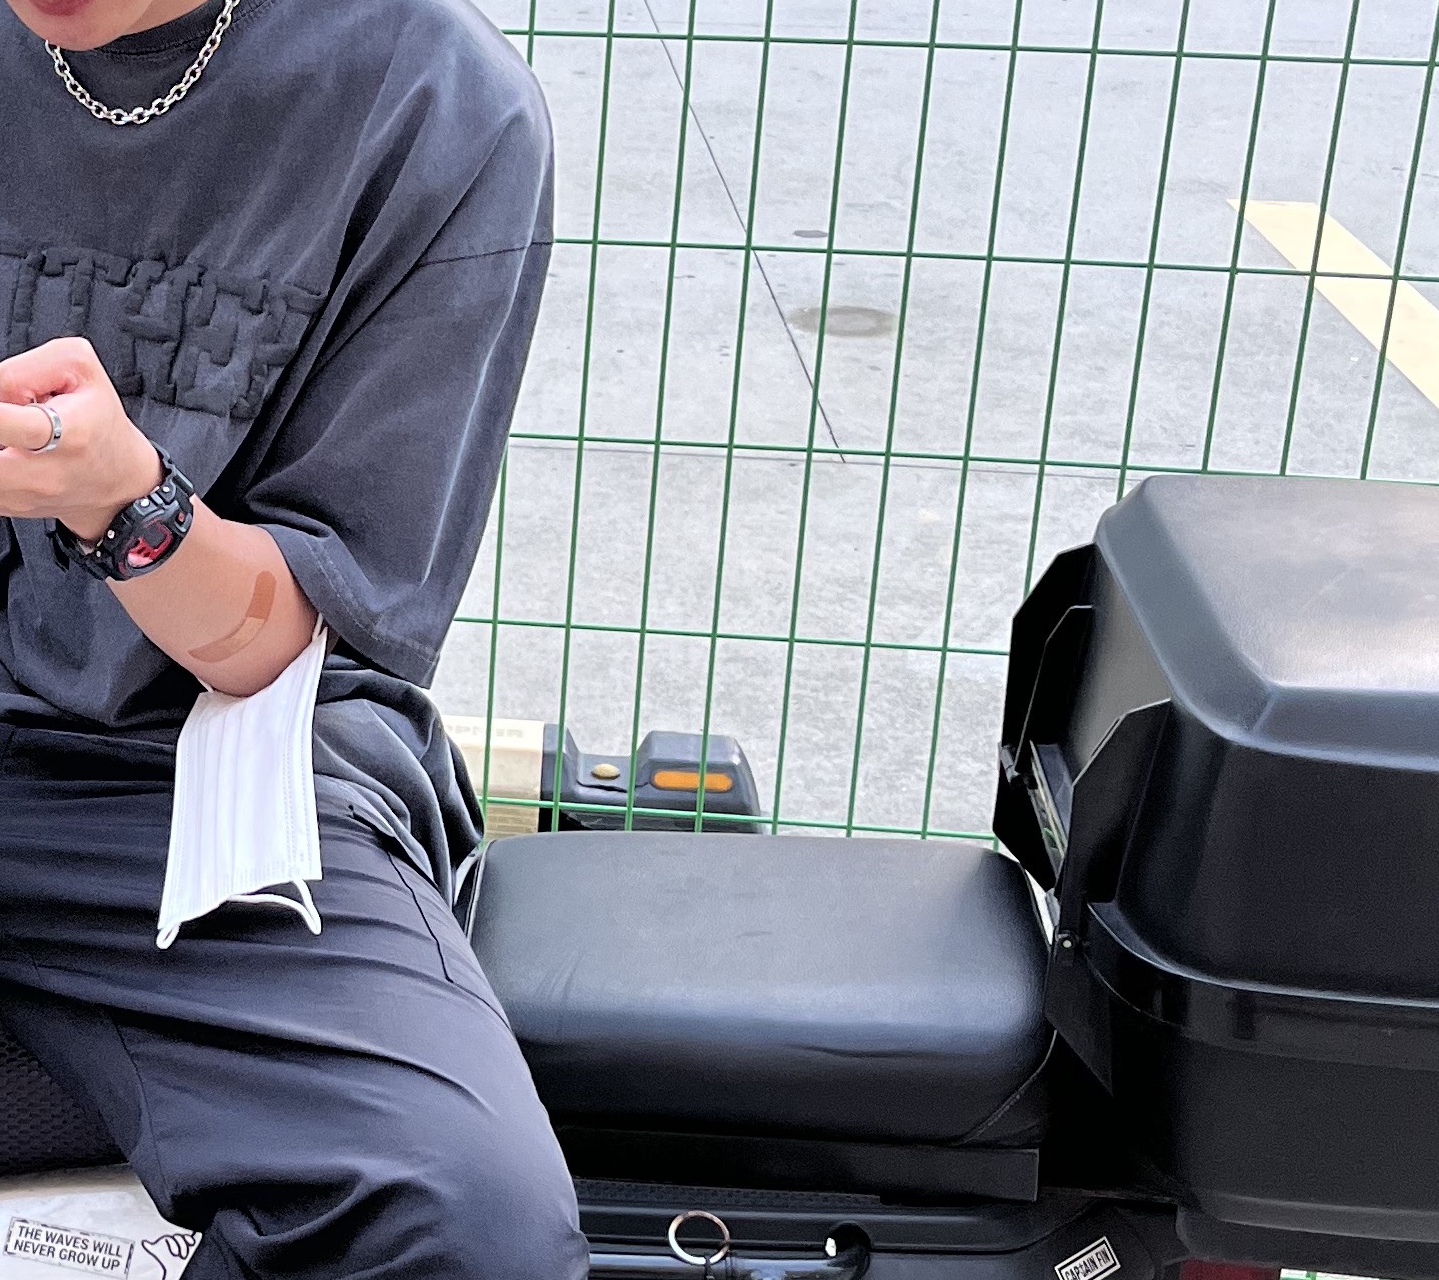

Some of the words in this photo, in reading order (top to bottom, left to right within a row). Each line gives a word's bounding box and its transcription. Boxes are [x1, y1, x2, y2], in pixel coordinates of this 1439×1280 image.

[13, 1239, 56, 1259] NEVER
[58, 1248, 99, 1269] GROW
[101, 1258, 121, 1271] UP
[18, 1225, 43, 1241] THE
[44, 1230, 90, 1251] WAVES
[92, 1239, 123, 1258] WILL
